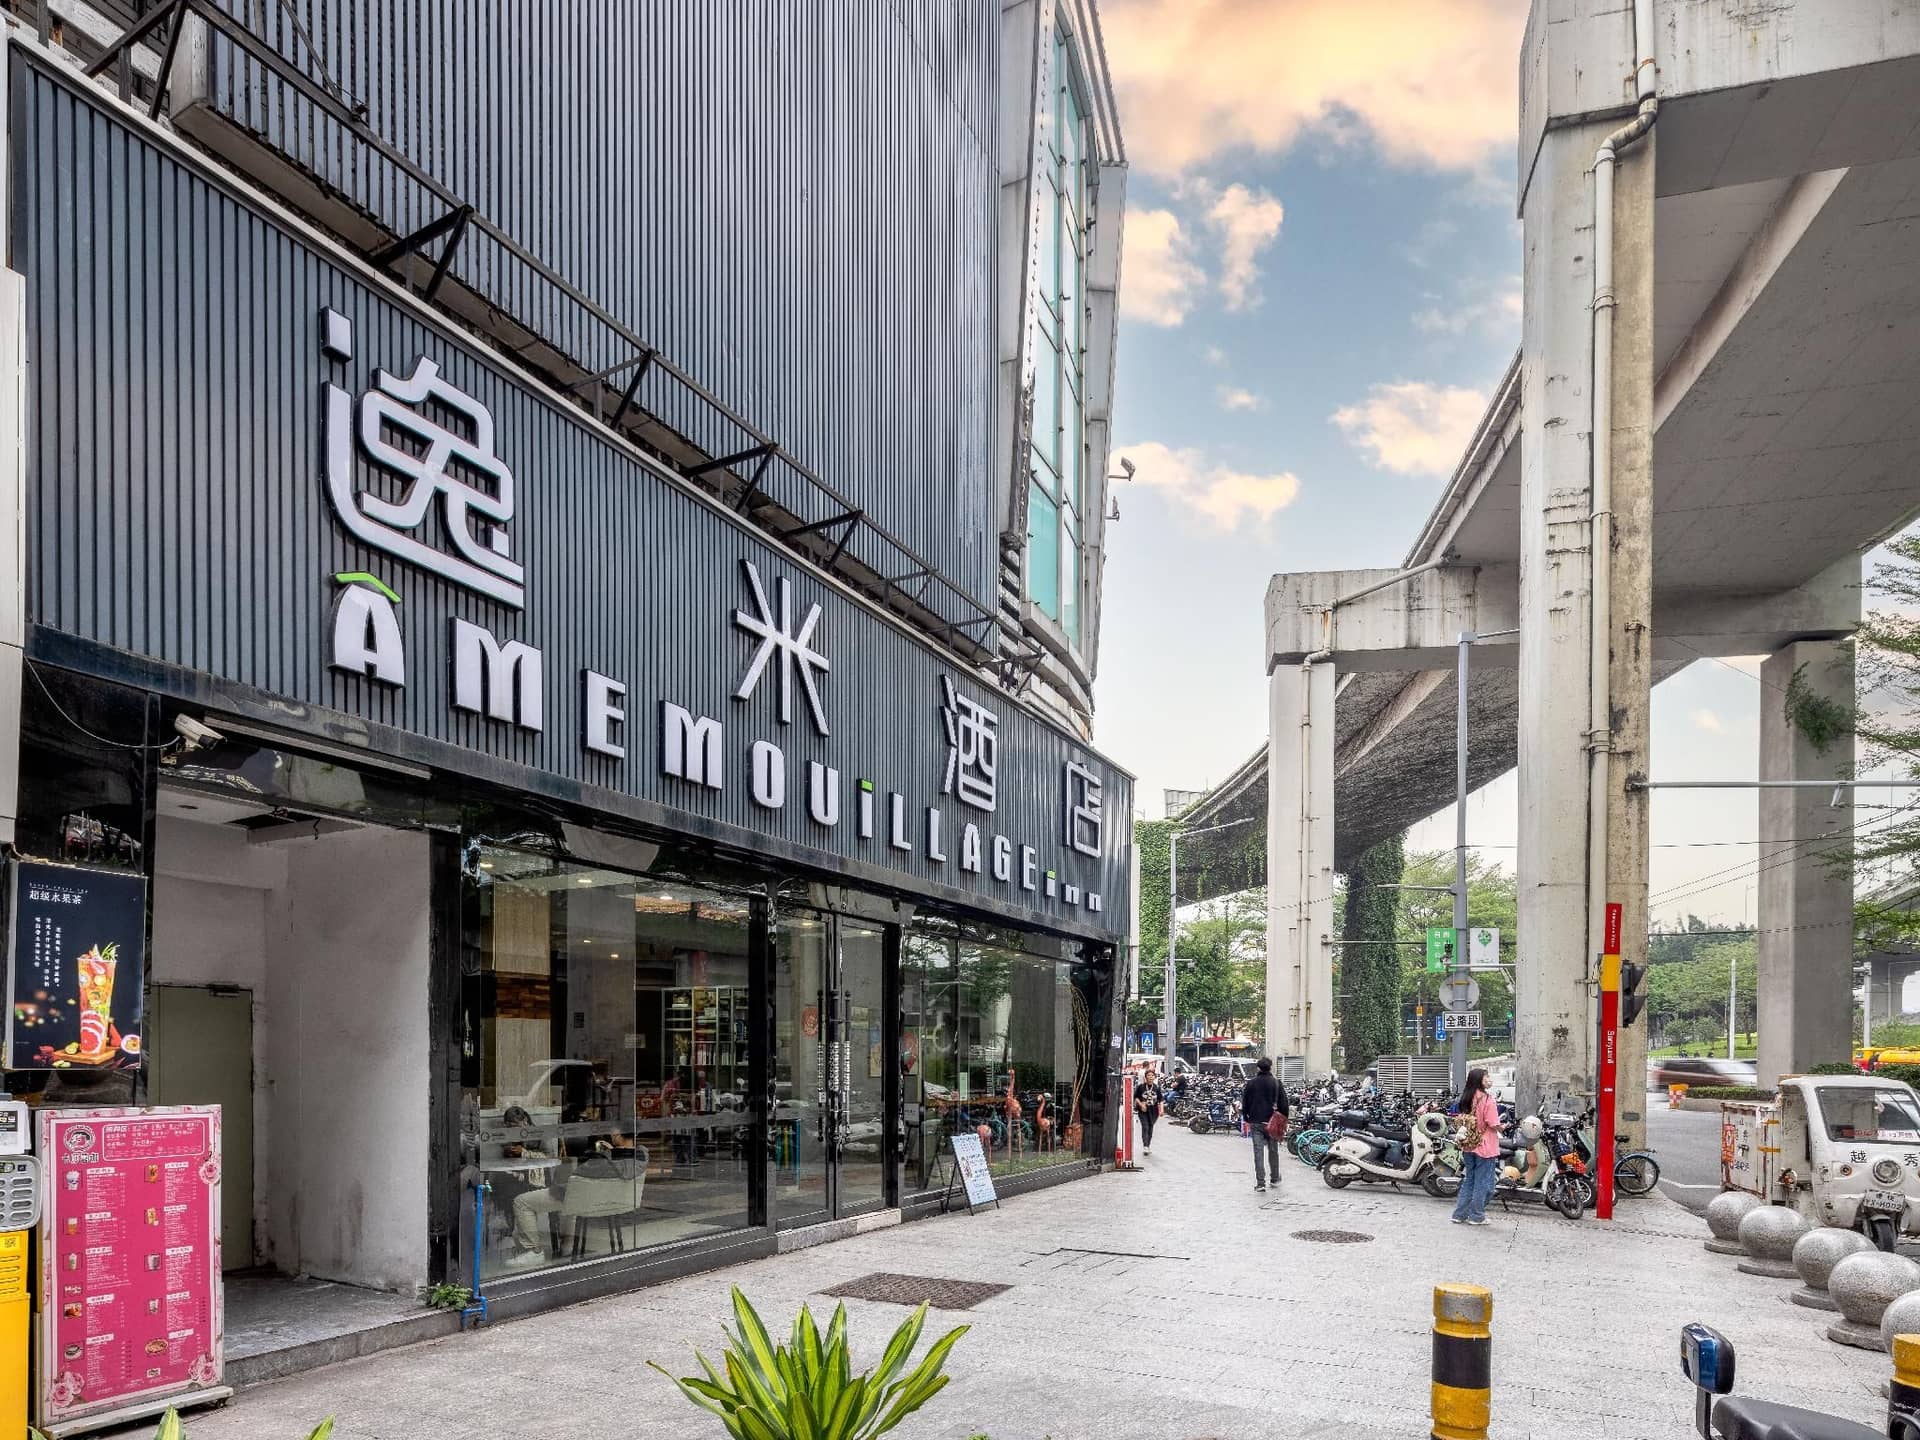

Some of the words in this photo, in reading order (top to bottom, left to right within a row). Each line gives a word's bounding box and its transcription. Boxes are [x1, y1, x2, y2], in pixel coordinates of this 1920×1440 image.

[29, 890, 82, 905] 超级水果茶
[1446, 1014, 1479, 1028] 全路段
